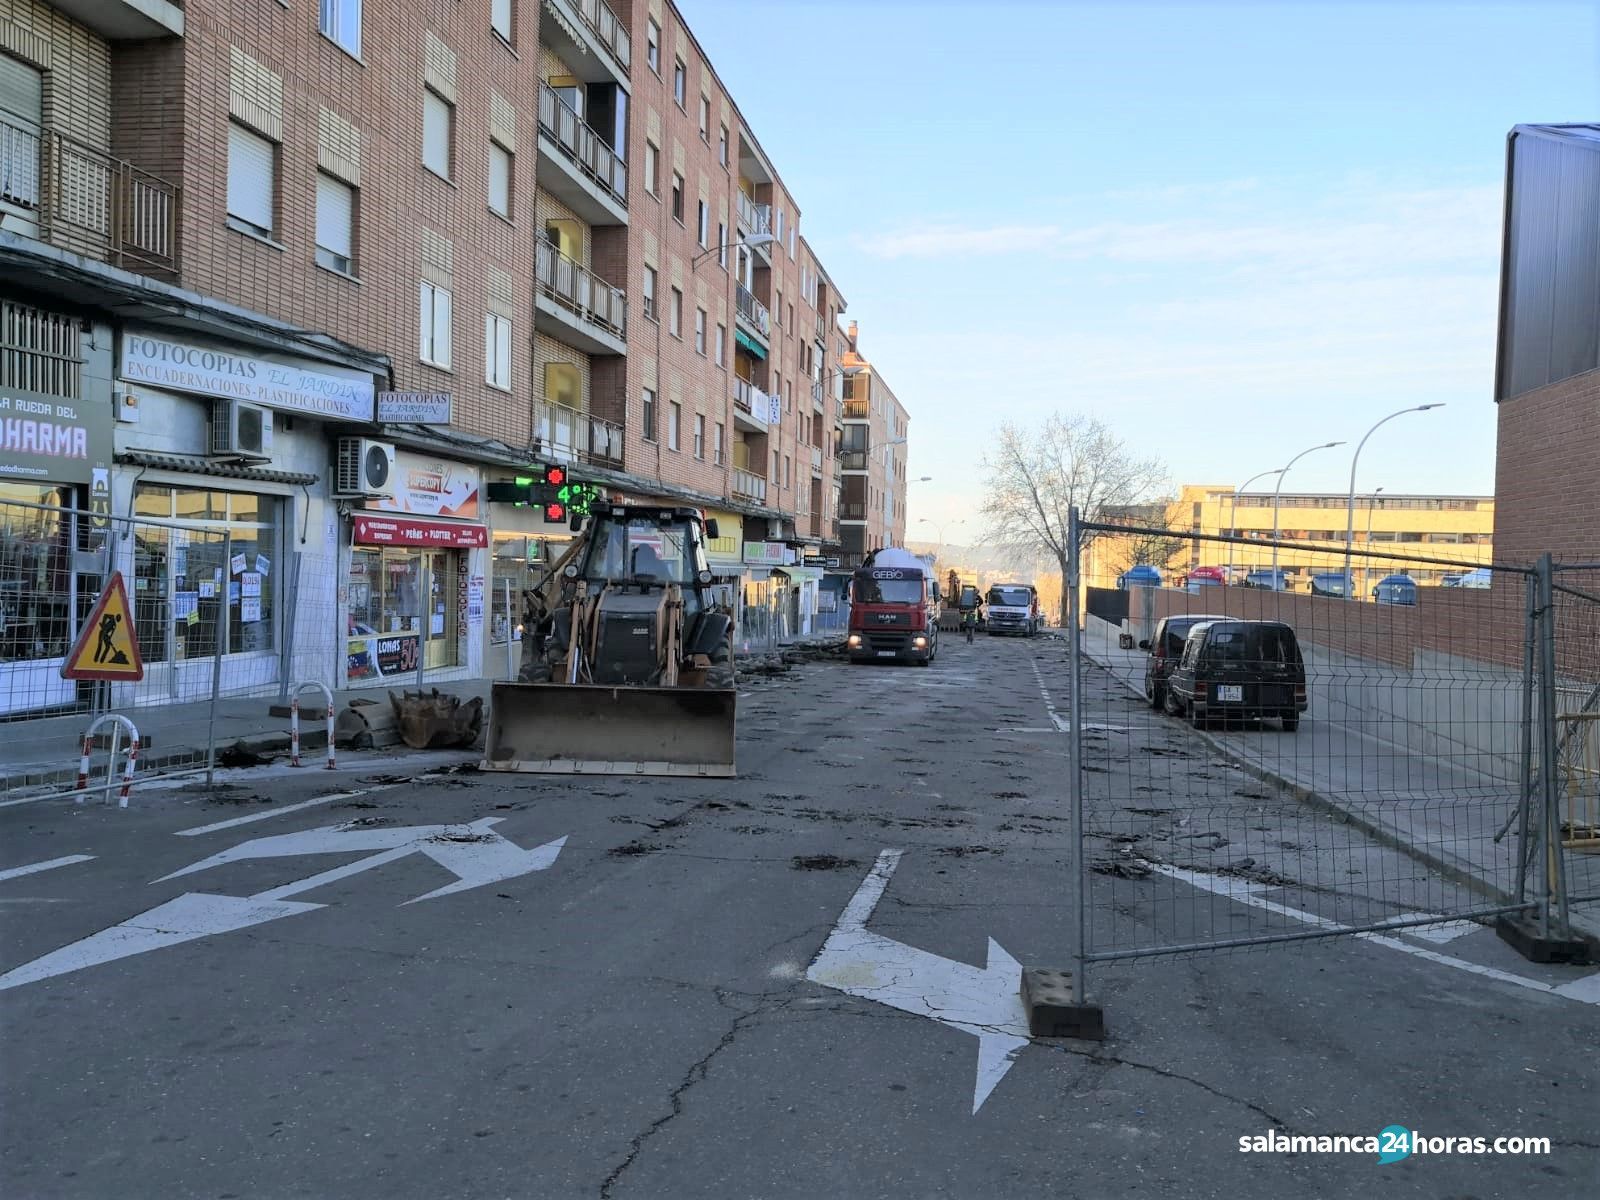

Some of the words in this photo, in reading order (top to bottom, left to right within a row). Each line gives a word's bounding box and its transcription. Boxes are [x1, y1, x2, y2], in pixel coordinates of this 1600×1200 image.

[129, 336, 257, 378] FOTOCOPIAS
[128, 361, 251, 396] ENCUADERNACIONES
[259, 386, 351, 414] PLASTIFICACIONES
[381, 393, 447, 404] FOTOCOPIAS
[15, 399, 52, 415] RUEDA
[56, 405, 77, 419] DEL
[429, 529, 451, 540] PLOTTER
[378, 640, 401, 654] LONAS
